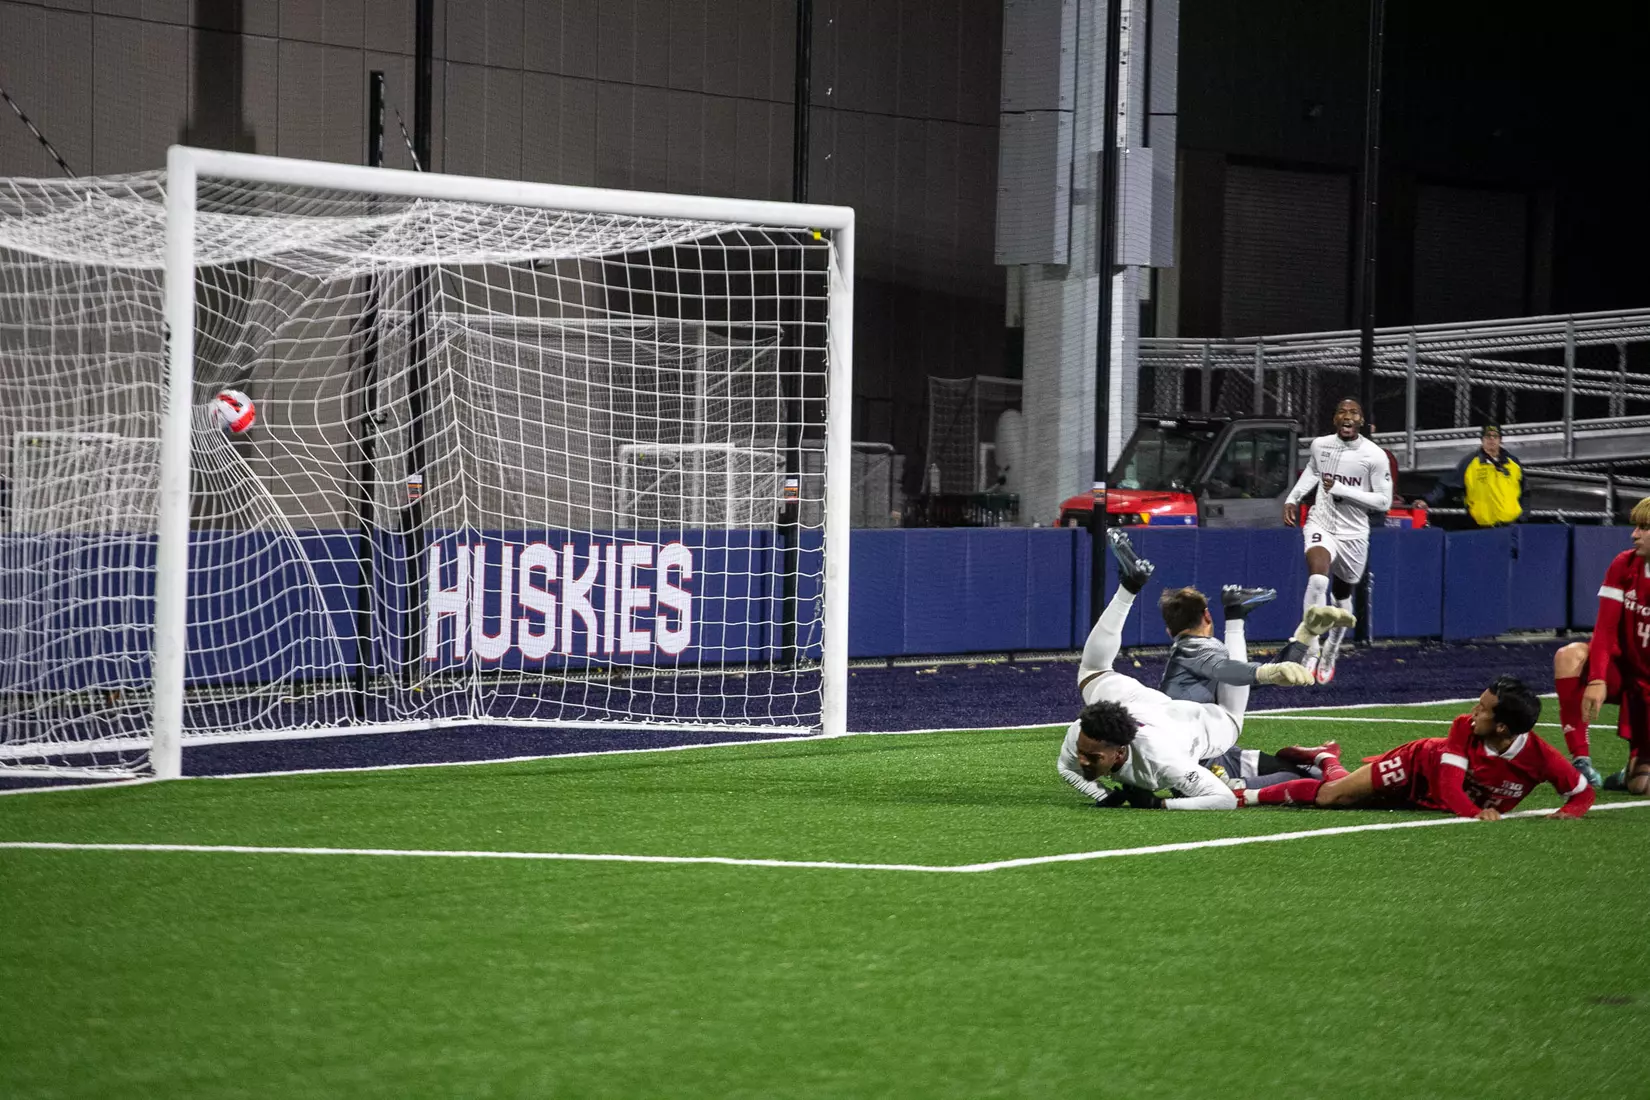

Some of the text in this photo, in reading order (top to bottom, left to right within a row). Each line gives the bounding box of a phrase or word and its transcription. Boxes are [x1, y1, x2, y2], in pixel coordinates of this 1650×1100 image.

[1311, 532, 1322, 543] 9
[426, 540, 693, 662] HUSKIES
[1378, 755, 1406, 786] 22
